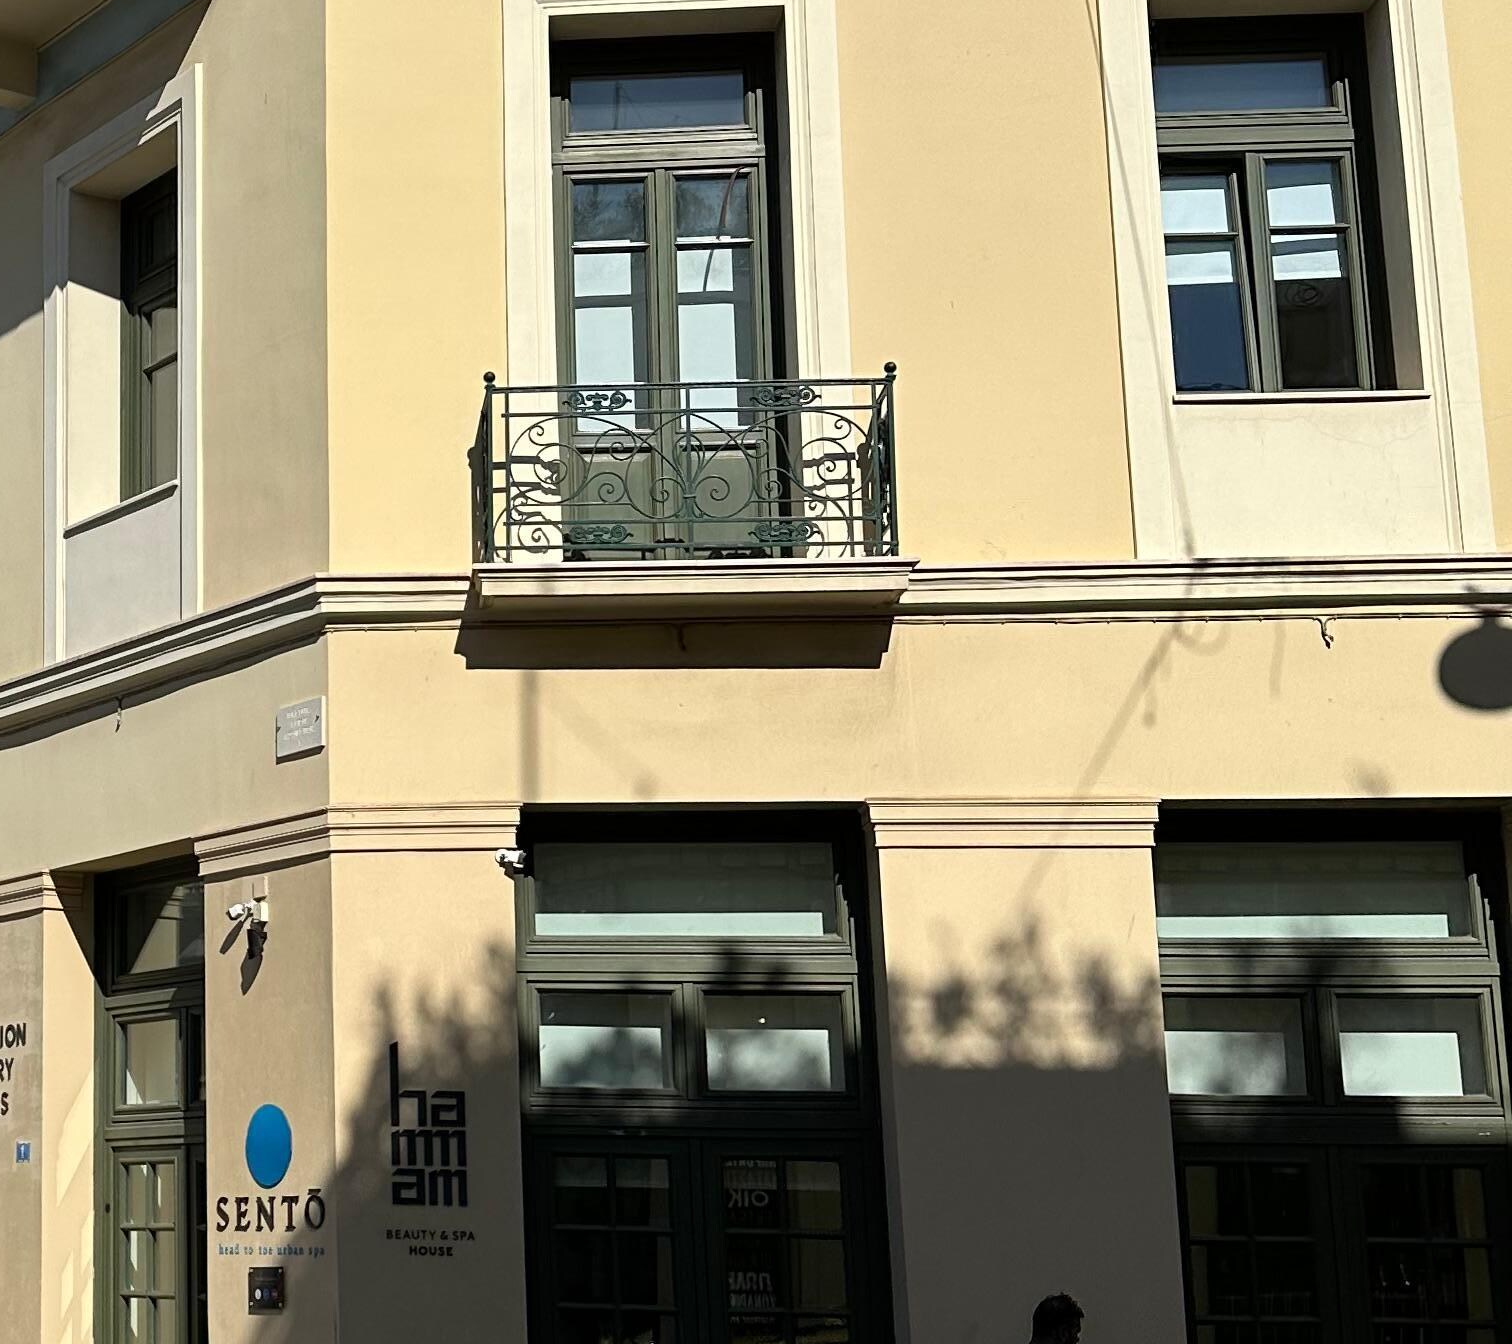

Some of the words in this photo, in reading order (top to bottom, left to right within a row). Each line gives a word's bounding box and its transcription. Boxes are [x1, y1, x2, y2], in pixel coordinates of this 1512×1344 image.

[216, 1188, 326, 1232] SENTŌ
[386, 1229, 436, 1240] BEAUTY
[440, 1230, 449, 1240] &
[452, 1230, 476, 1241] SPA
[218, 1243, 240, 1255] head
[244, 1245, 254, 1255] to
[258, 1245, 273, 1255] toe
[277, 1244, 305, 1255] urban
[308, 1246, 325, 1258] spa
[408, 1246, 454, 1256] HOUSE
